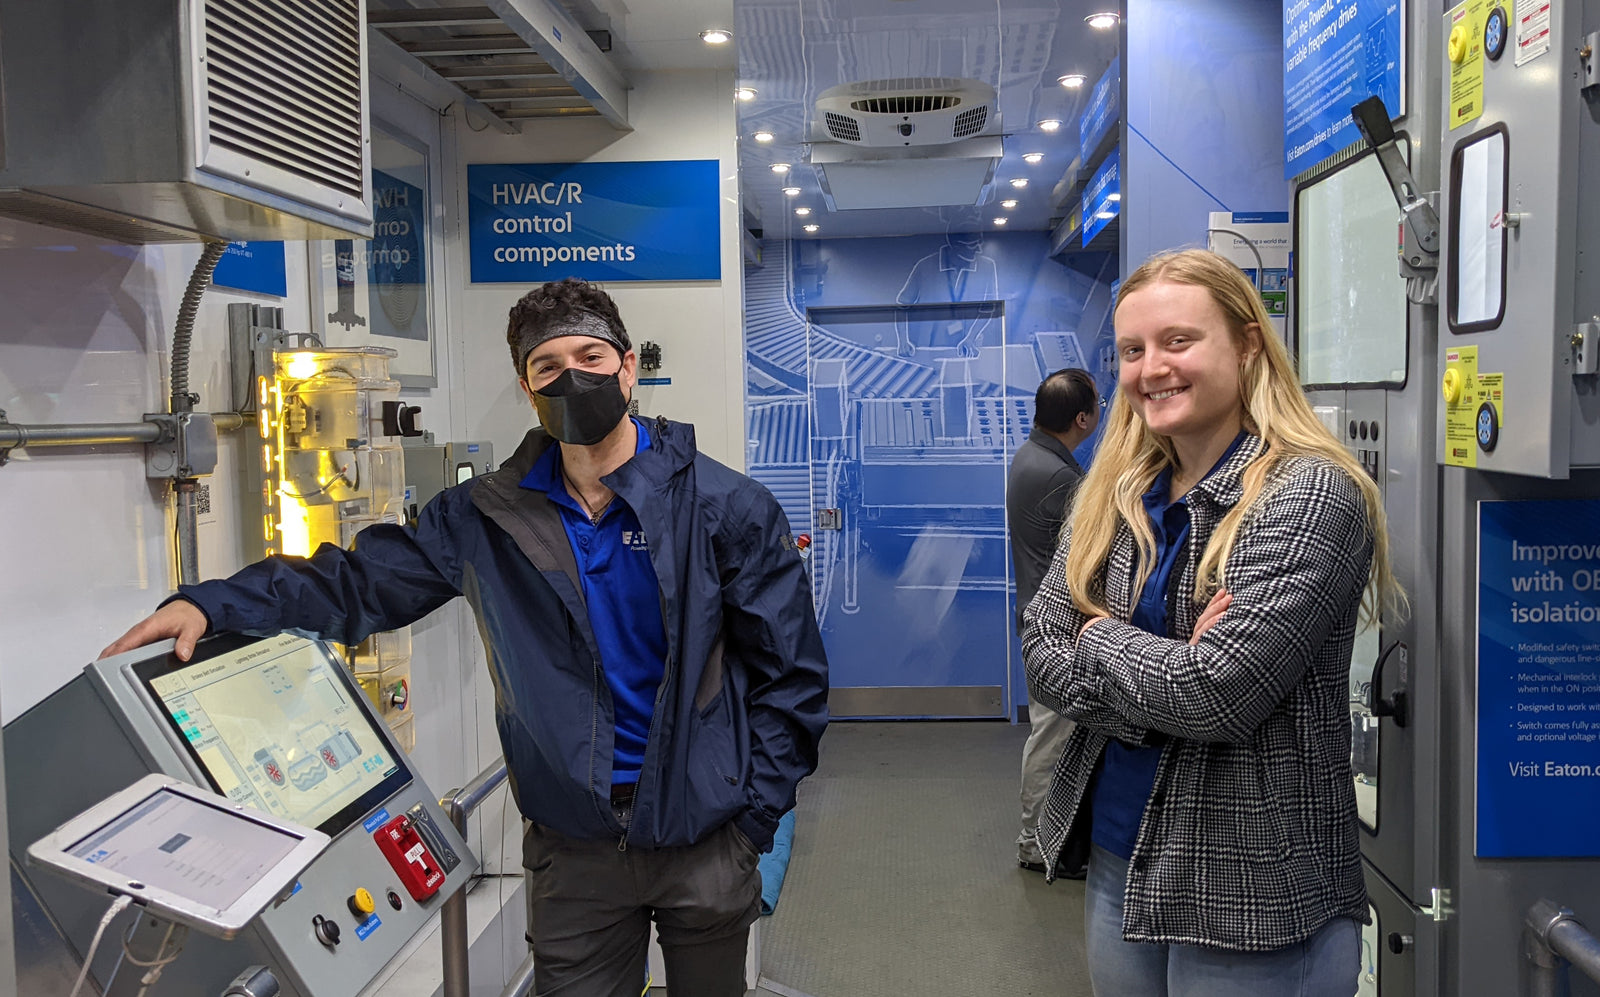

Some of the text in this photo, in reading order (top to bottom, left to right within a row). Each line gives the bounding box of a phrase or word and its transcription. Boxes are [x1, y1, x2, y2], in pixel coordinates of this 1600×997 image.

[1286, 26, 1299, 48] with
[1299, 20, 1308, 38] the
[1286, 2, 1357, 72] variable frequency drives
[492, 182, 583, 206] HVAC/R
[493, 211, 572, 234] control
[493, 243, 636, 267] components
[1511, 570, 1564, 592] with
[1518, 643, 1554, 652] Modified
[1556, 643, 1579, 653] safety
[1518, 655, 1533, 663] and
[1535, 655, 1576, 665] dangerous
[1517, 673, 1561, 682] Mechanical
[1518, 685, 1539, 693] when
[1551, 685, 1564, 693] the
[1566, 684, 1580, 692] ON
[1517, 703, 1555, 713] Designed
[1567, 703, 1586, 711] work
[1517, 721, 1542, 730] Switch
[1544, 722, 1570, 730] comes
[1572, 721, 1589, 731] fully
[1517, 733, 1596, 742] and optional voltage
[1509, 761, 1540, 777] Visit
